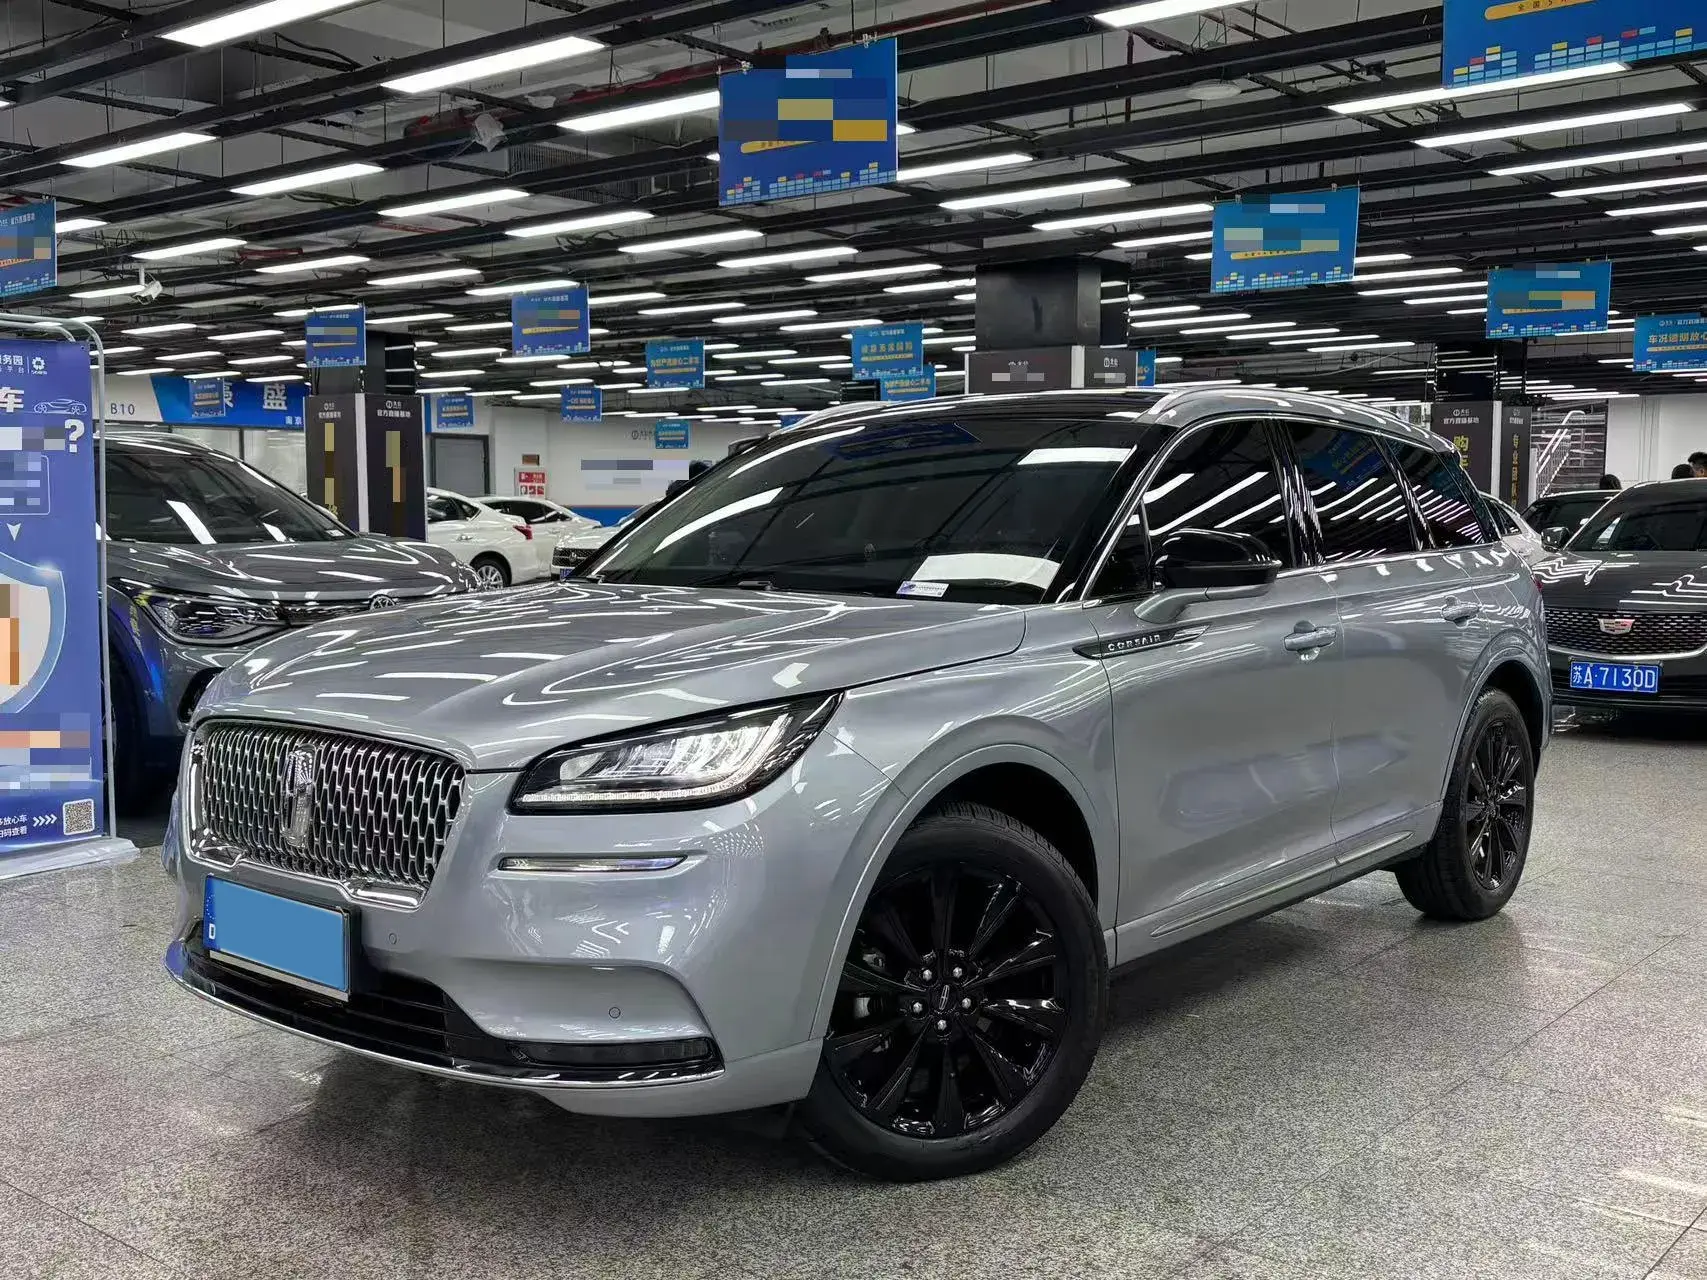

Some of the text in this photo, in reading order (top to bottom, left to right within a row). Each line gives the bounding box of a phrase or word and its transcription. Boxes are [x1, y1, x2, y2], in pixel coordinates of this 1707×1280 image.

[0, 354, 23, 366] 务园
[110, 402, 135, 416] B10
[1107, 634, 1161, 652] CORSAIR
